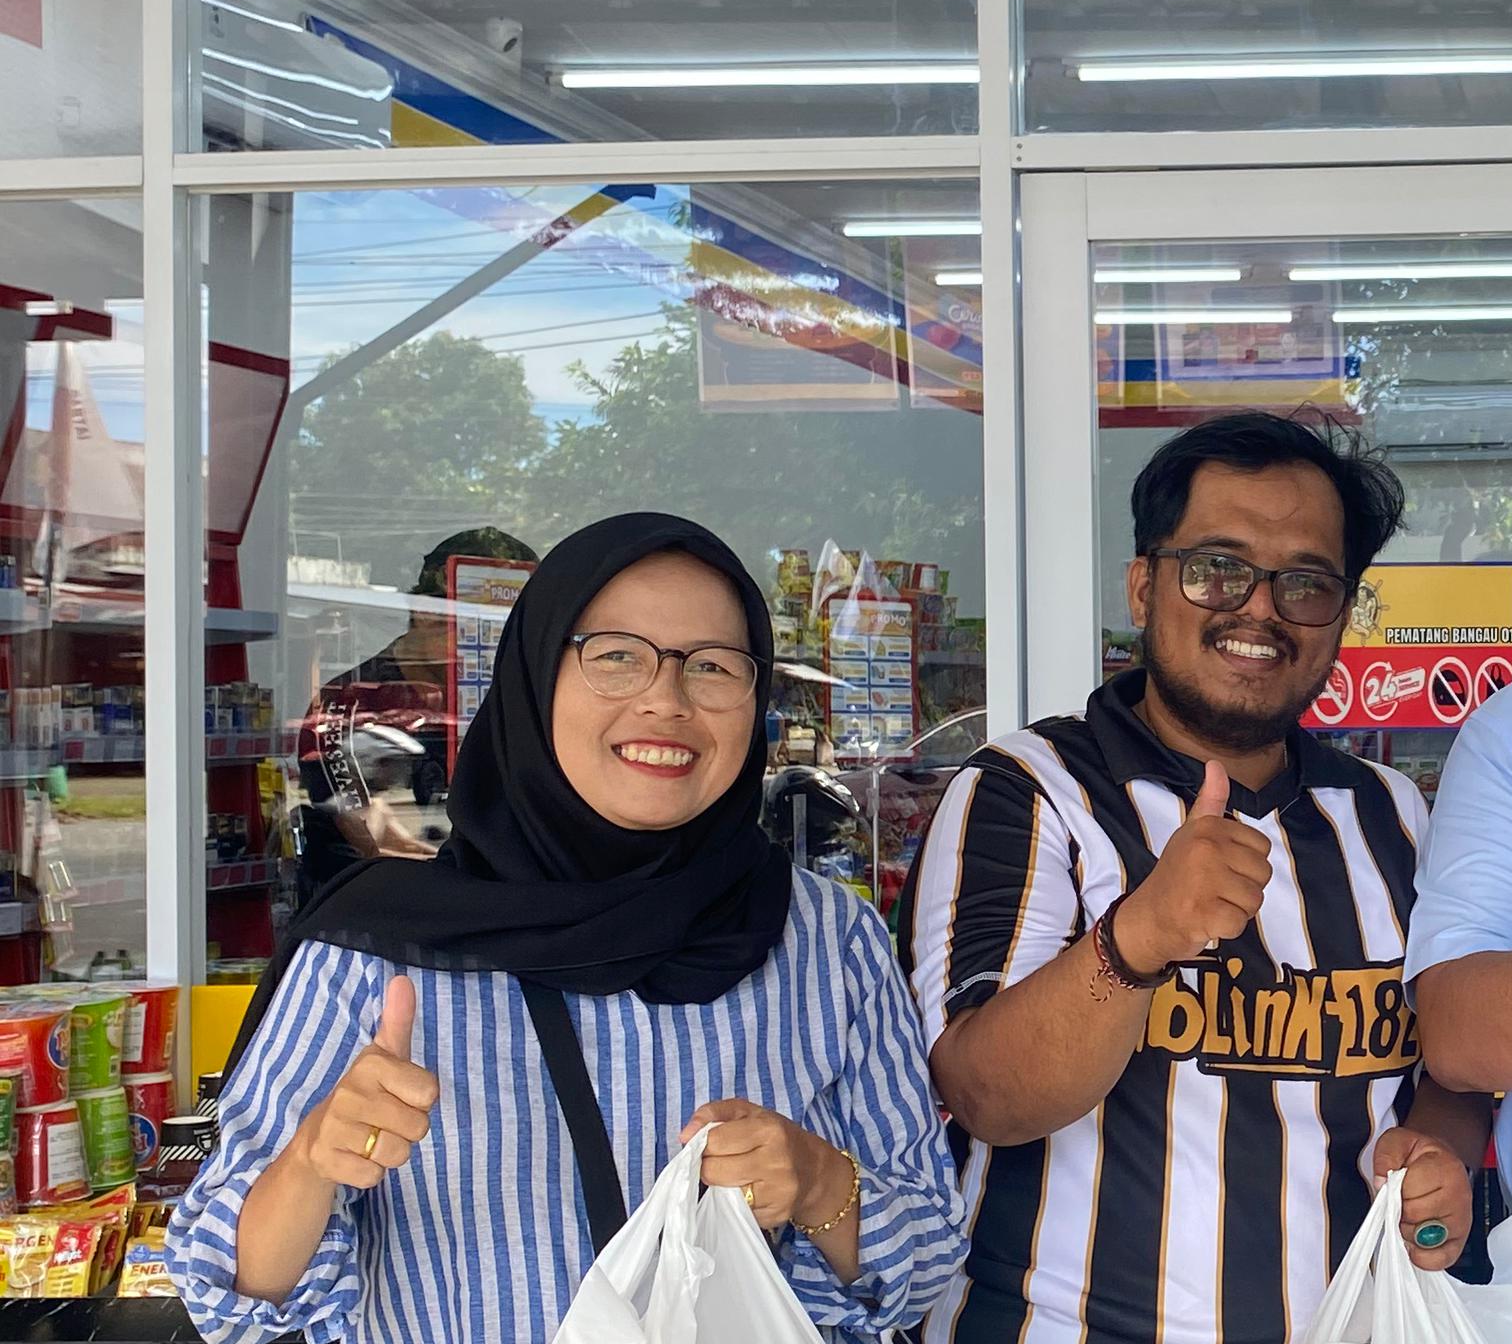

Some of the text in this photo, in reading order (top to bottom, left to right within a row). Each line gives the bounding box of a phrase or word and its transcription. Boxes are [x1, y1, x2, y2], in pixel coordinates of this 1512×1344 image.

[1385, 627, 1449, 645] PEMATANG
[1452, 627, 1499, 644] BANGAU
[1366, 671, 1397, 706] 24
